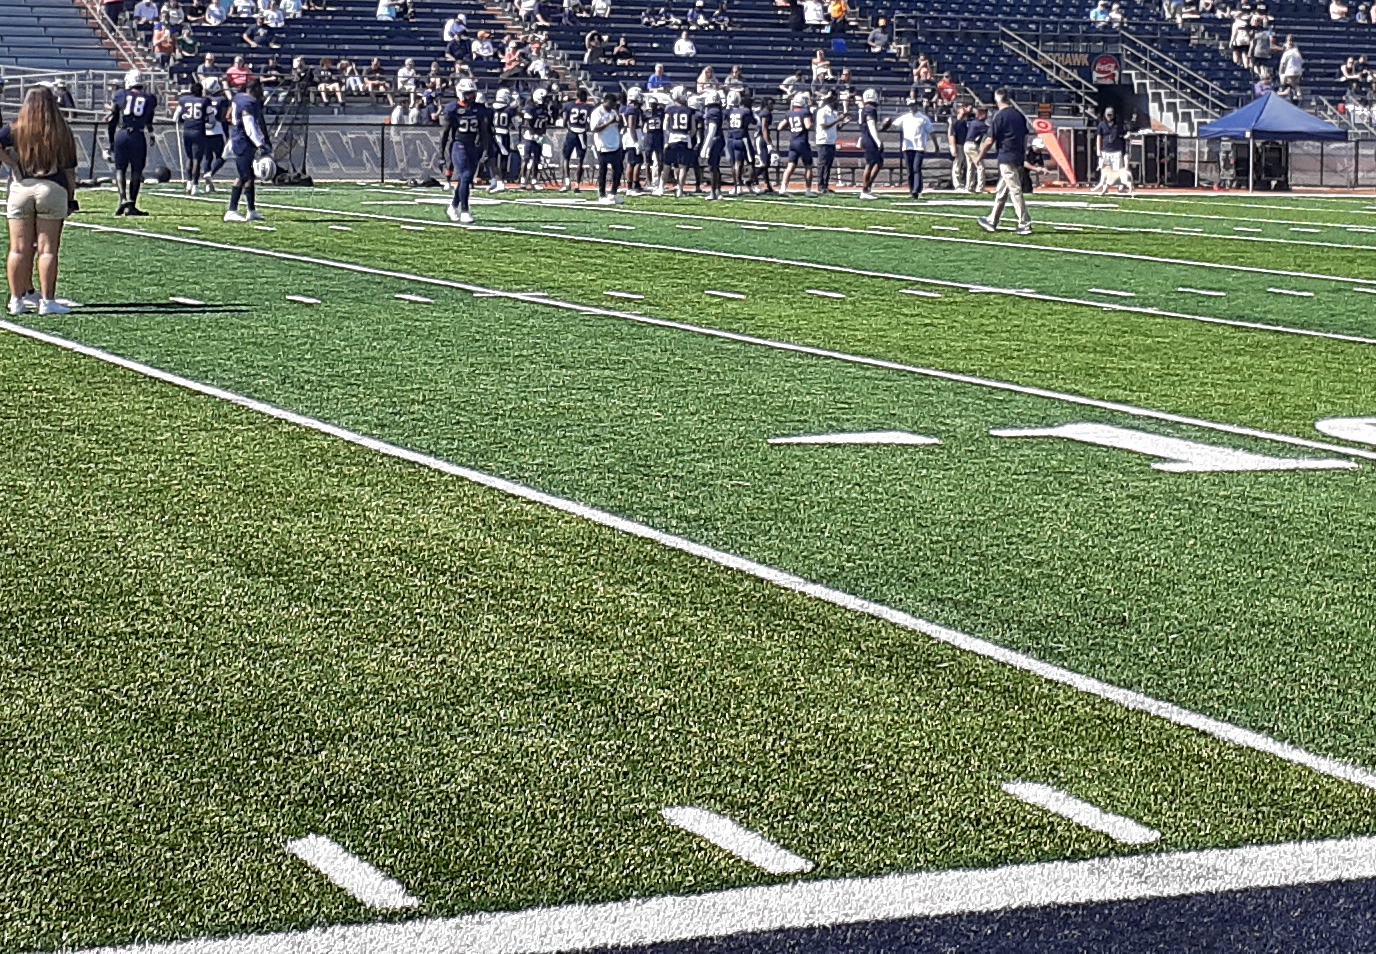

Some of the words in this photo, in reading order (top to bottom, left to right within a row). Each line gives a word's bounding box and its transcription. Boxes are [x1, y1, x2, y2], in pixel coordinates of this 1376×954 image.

[123, 95, 146, 117] 18
[182, 102, 203, 120] 36
[569, 107, 588, 125] 23
[672, 112, 689, 130] 19
